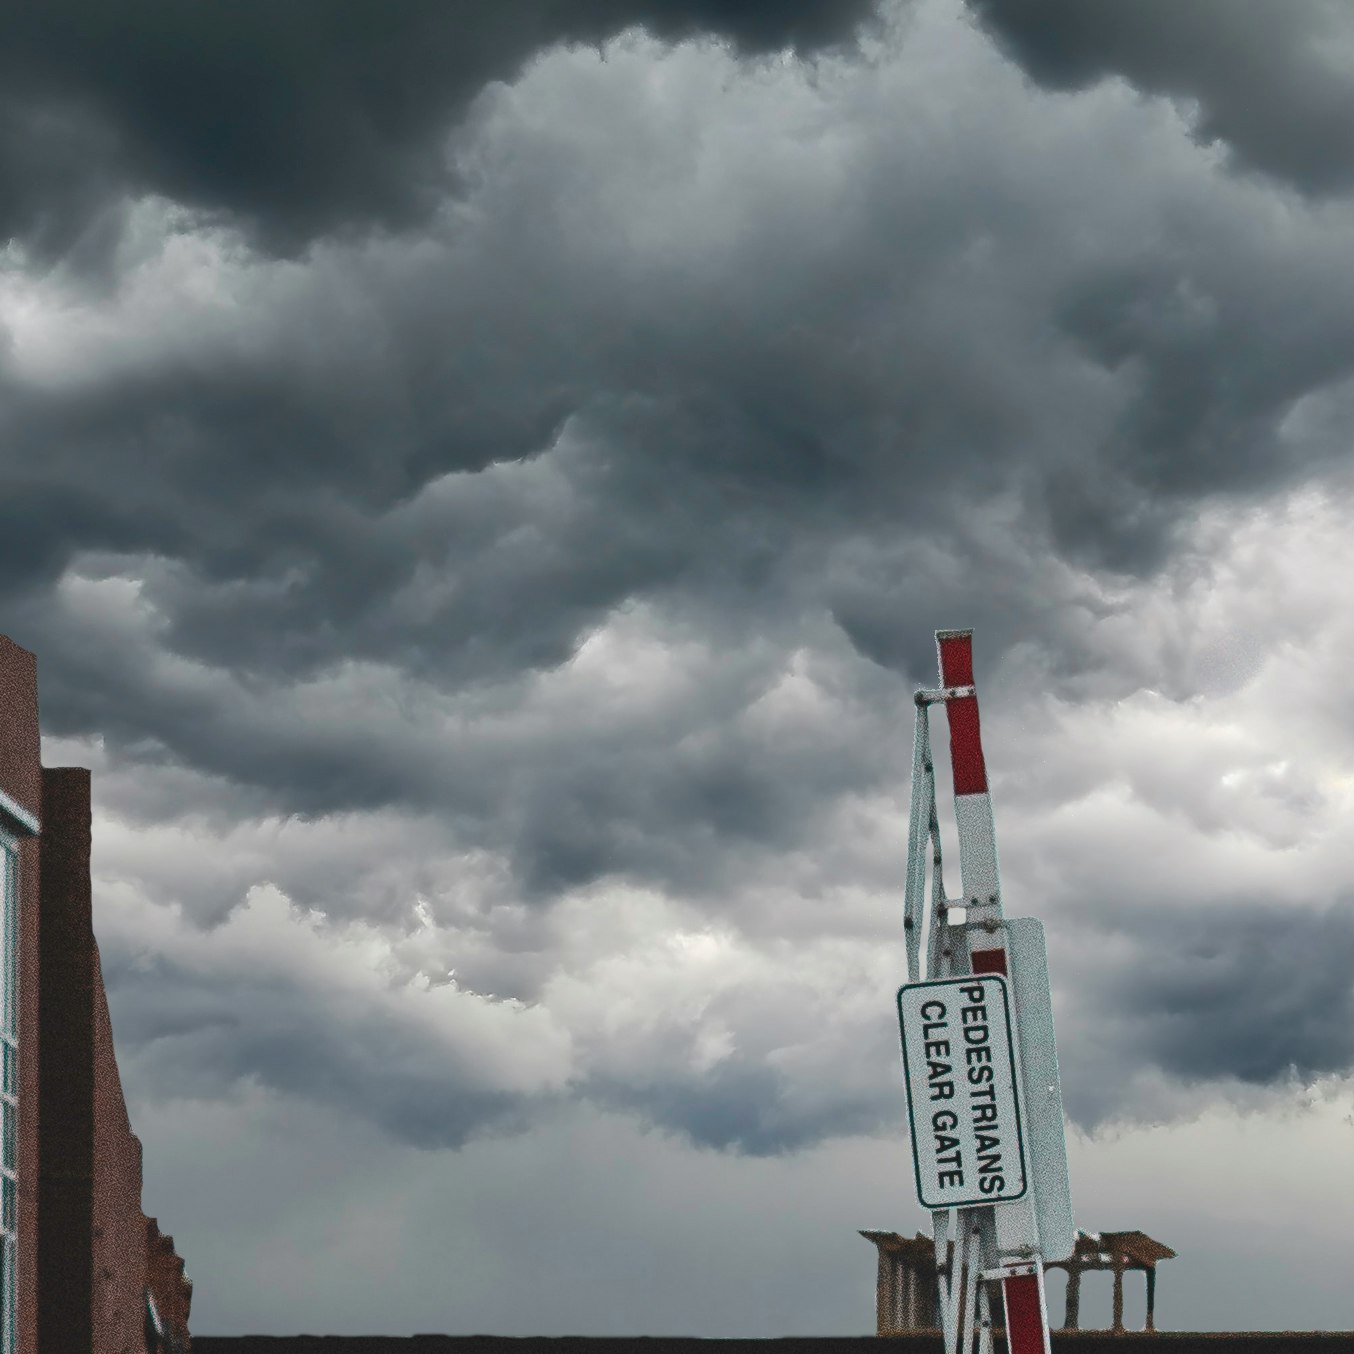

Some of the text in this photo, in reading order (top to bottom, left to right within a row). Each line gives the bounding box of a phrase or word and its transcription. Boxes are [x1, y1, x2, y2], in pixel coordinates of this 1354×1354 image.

[920, 1000, 964, 1190] CLEAR GATE
[959, 985, 1006, 1195] PEDESTRIANS
